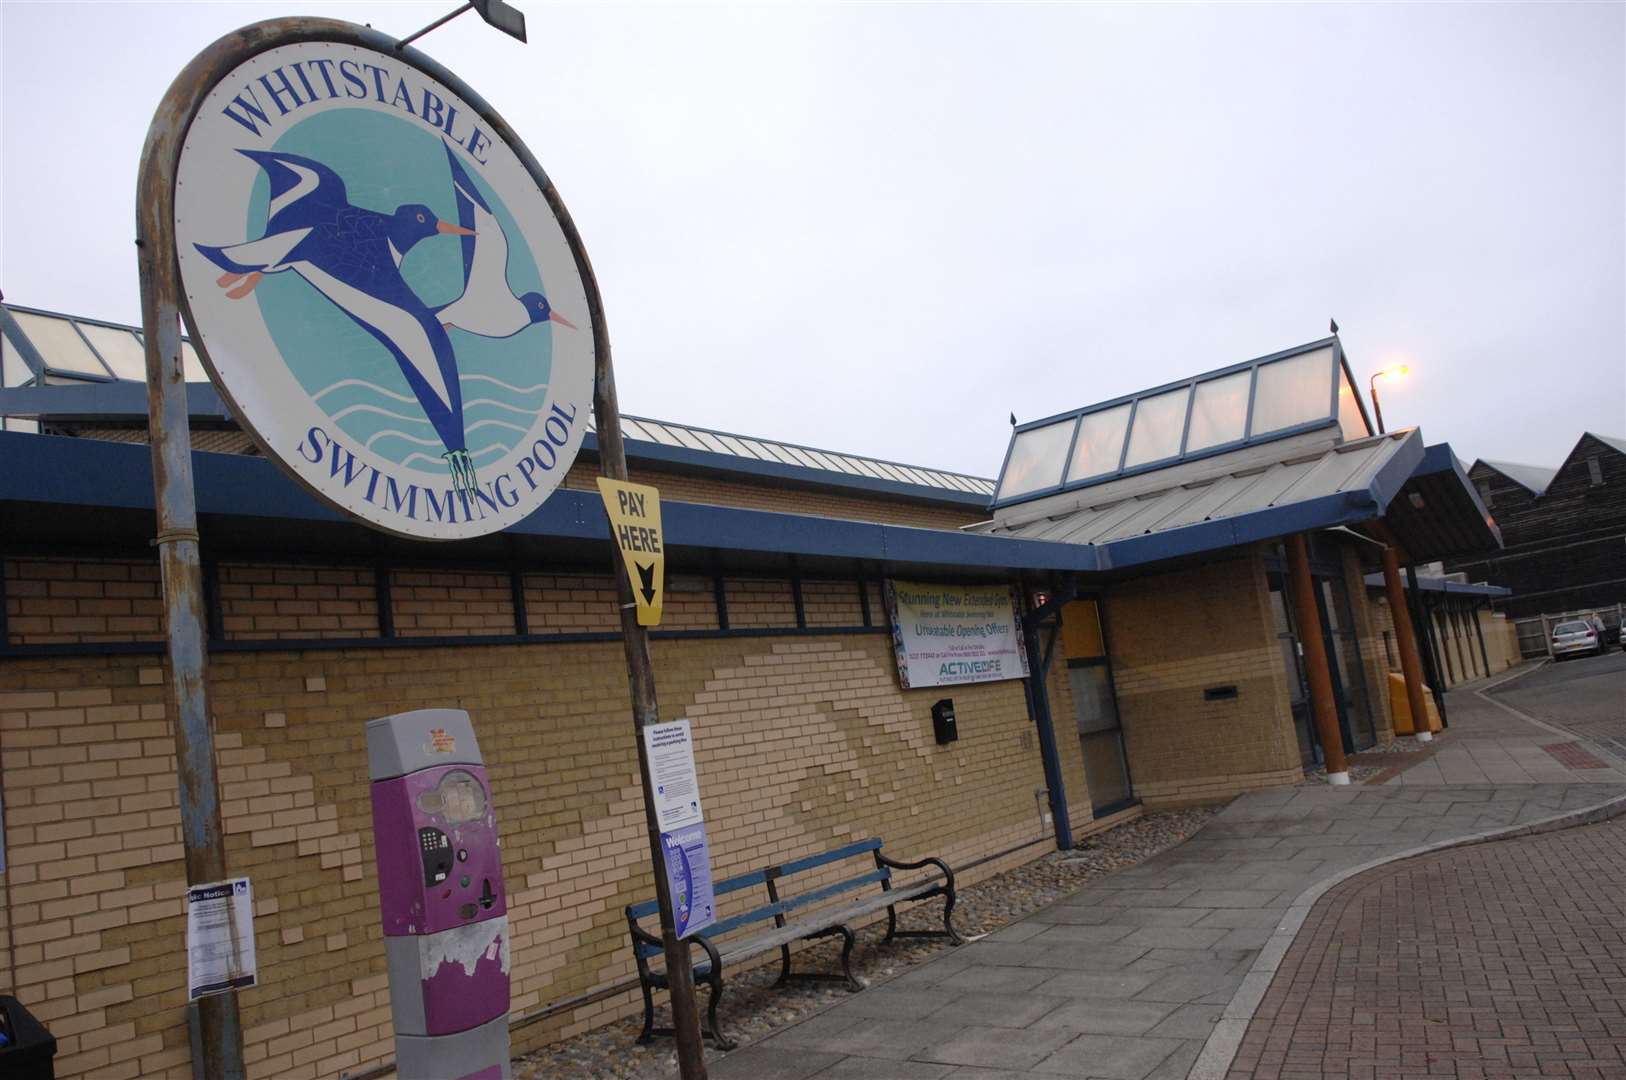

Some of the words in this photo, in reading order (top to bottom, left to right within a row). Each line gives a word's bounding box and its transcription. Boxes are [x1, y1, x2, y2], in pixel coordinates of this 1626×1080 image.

[221, 59, 493, 166] WHITSTABLE
[297, 426, 520, 523] SWIMMING
[516, 400, 577, 492] POOL
[617, 489, 646, 518] PAY
[617, 524, 661, 553] HERE
[897, 591, 940, 608] Stunning
[942, 592, 962, 606] New
[985, 623, 1009, 637] Offers
